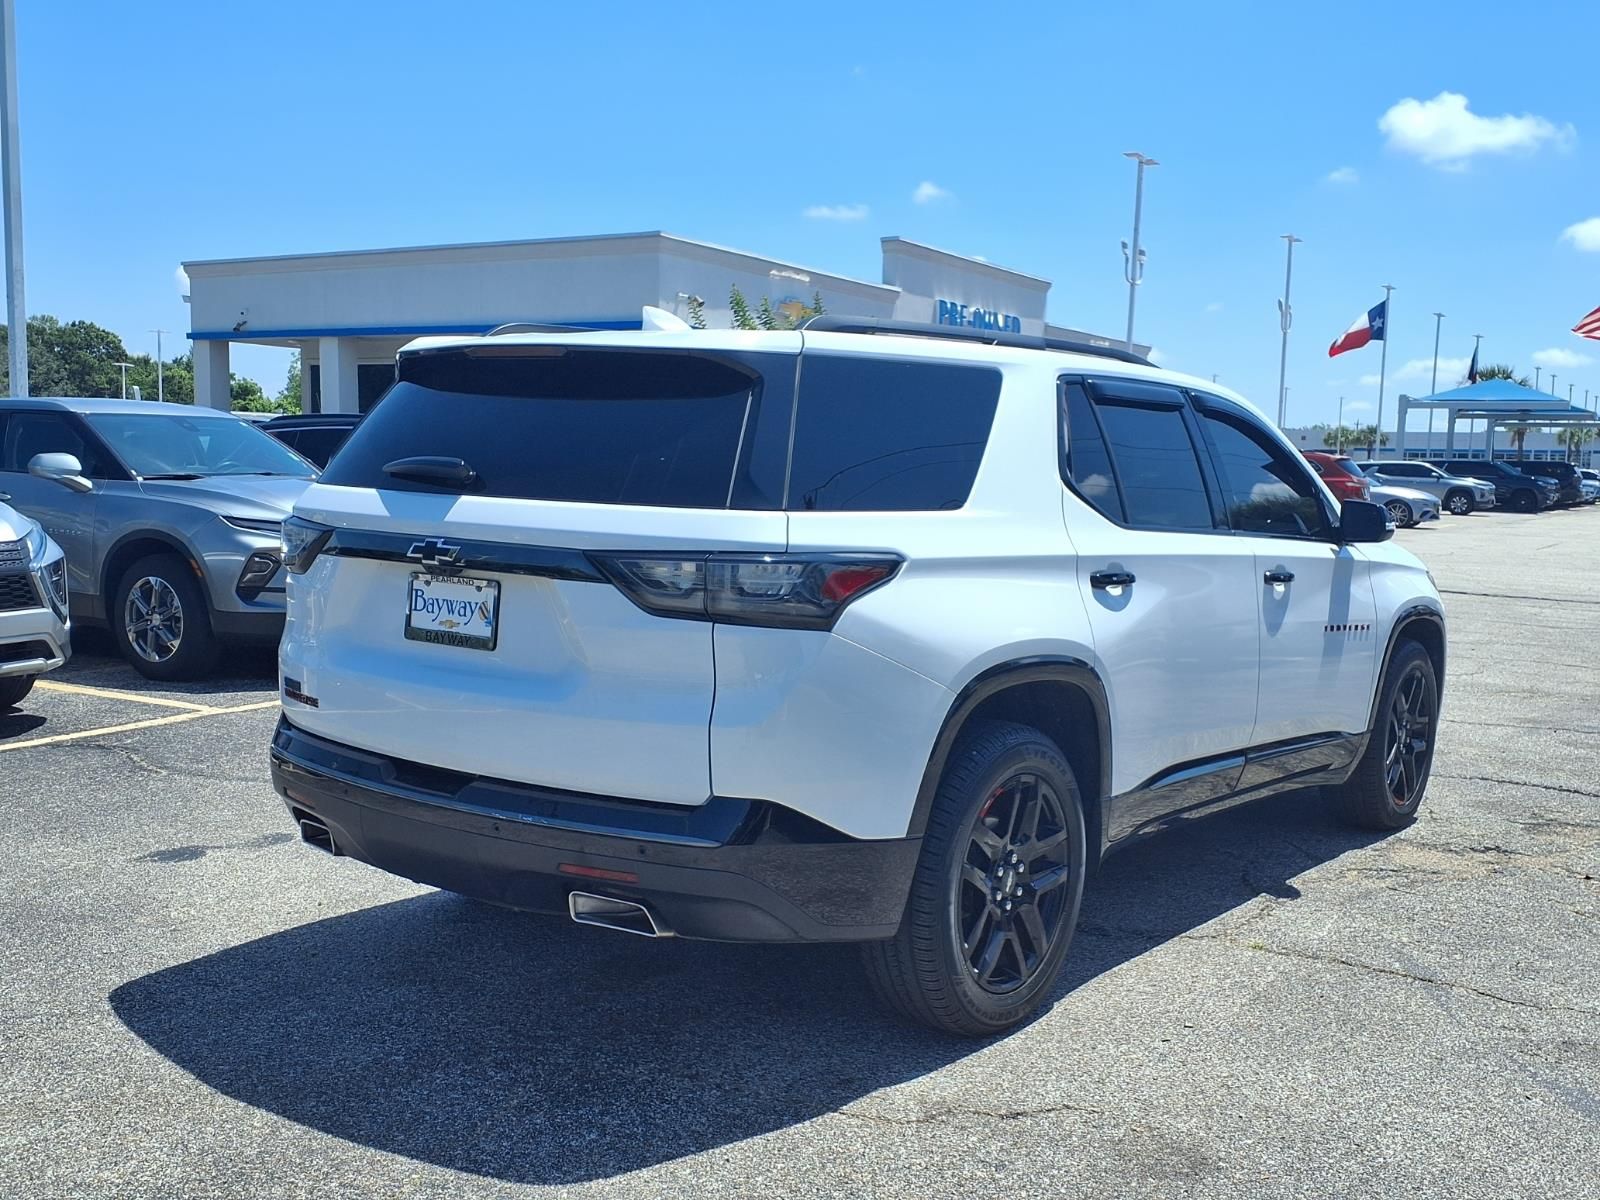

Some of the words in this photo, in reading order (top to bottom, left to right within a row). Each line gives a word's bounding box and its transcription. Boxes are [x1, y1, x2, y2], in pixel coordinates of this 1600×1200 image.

[430, 575, 475, 586] PEARLAND
[412, 588, 479, 626] Bayway
[425, 631, 472, 646] BAYWAY
